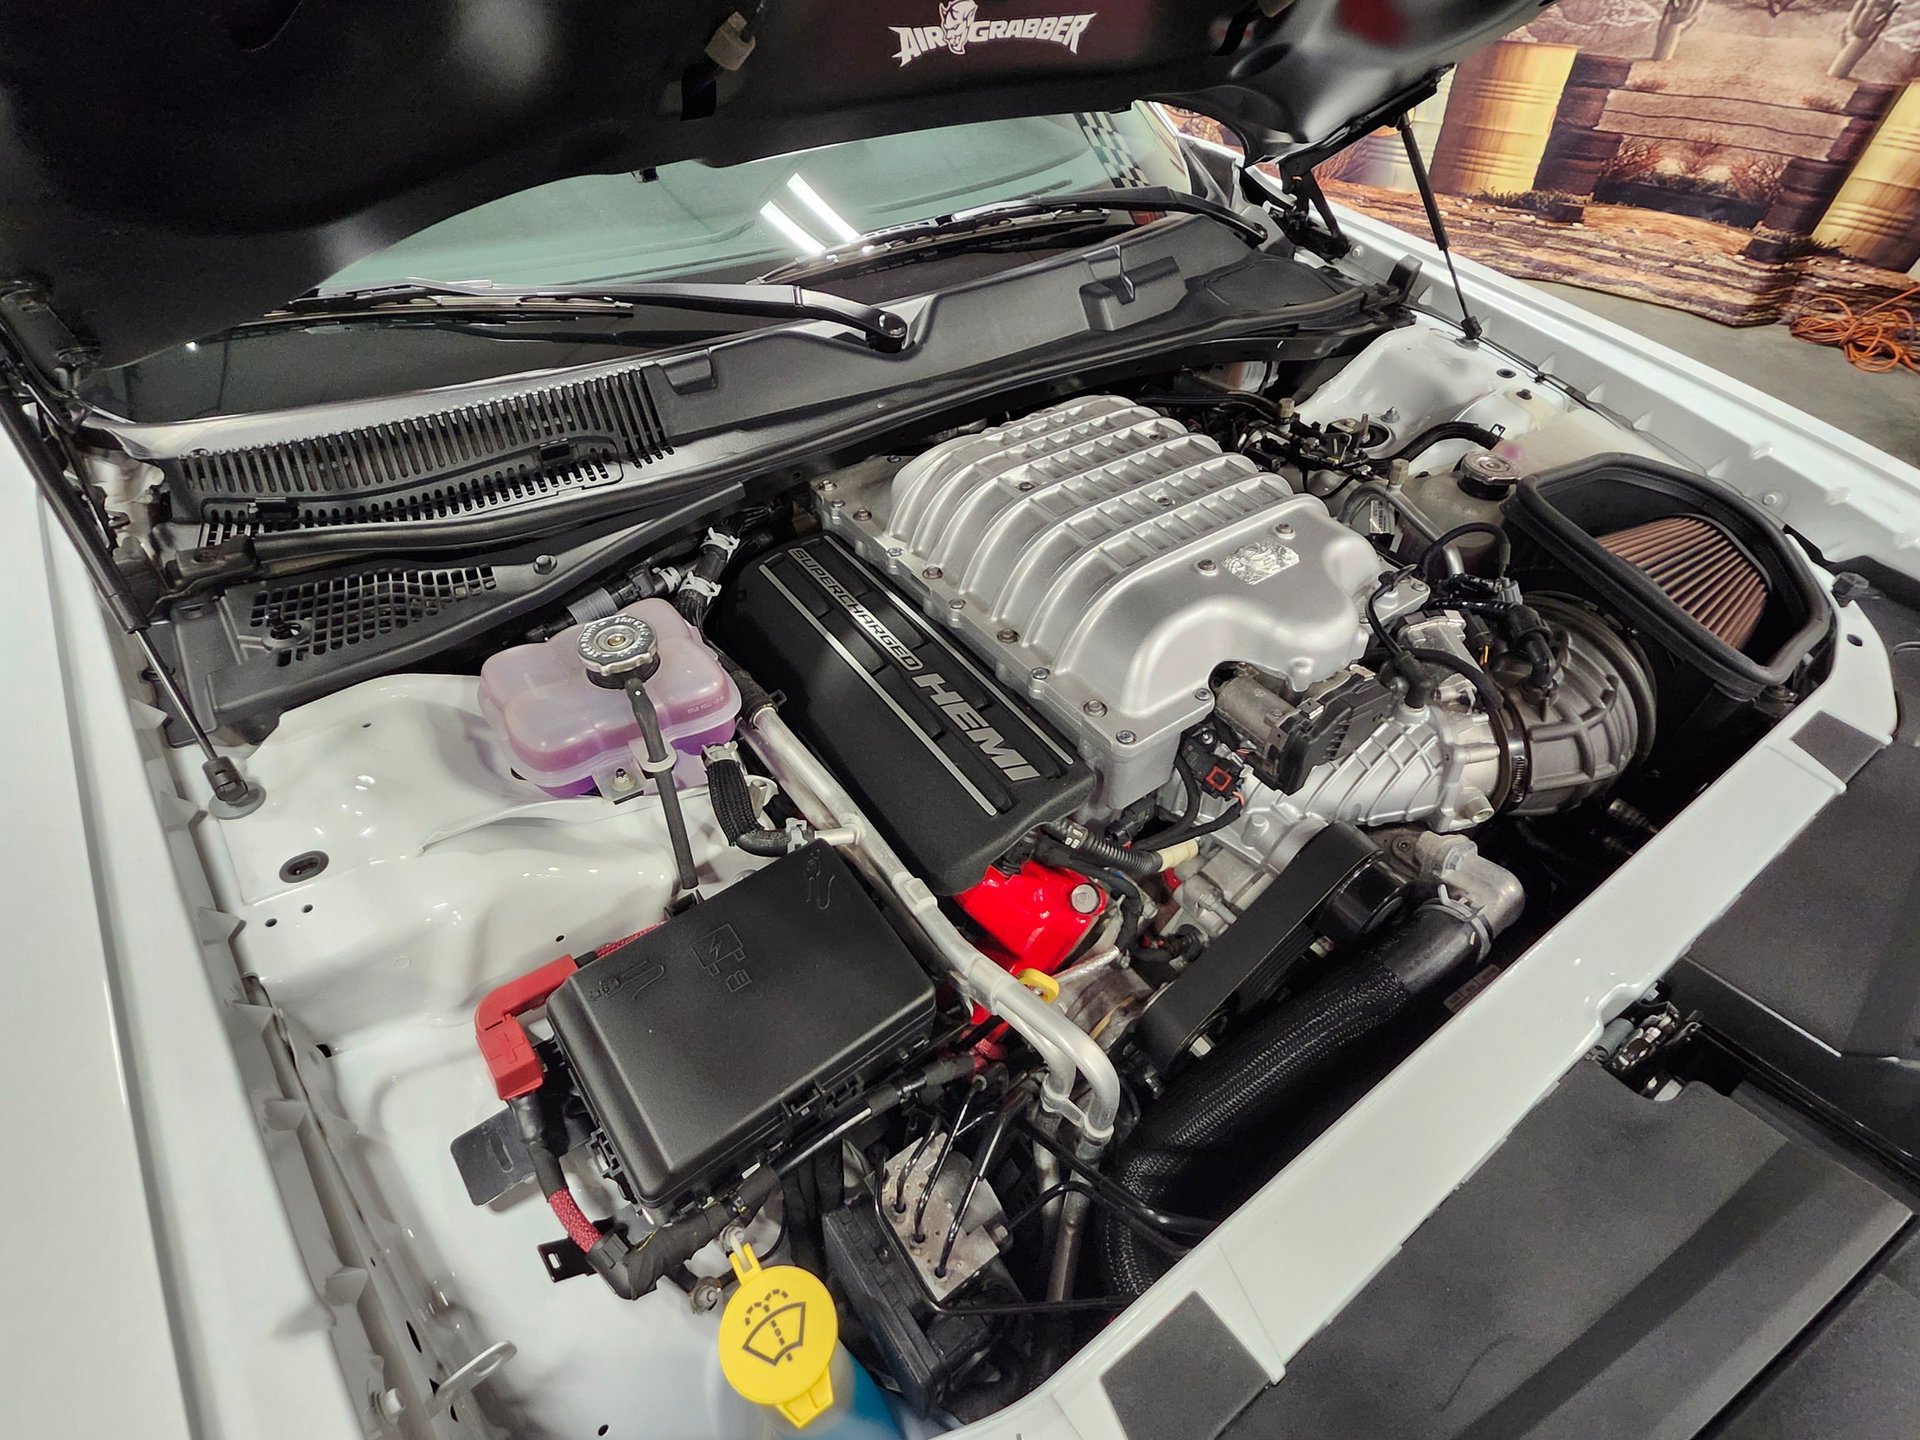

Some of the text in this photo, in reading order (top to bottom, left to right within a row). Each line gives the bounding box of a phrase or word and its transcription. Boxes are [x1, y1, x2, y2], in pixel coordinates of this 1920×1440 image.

[888, 12, 1098, 67] AIR GRABBER
[790, 548, 1041, 781] SUPERCHARGED HEMI
